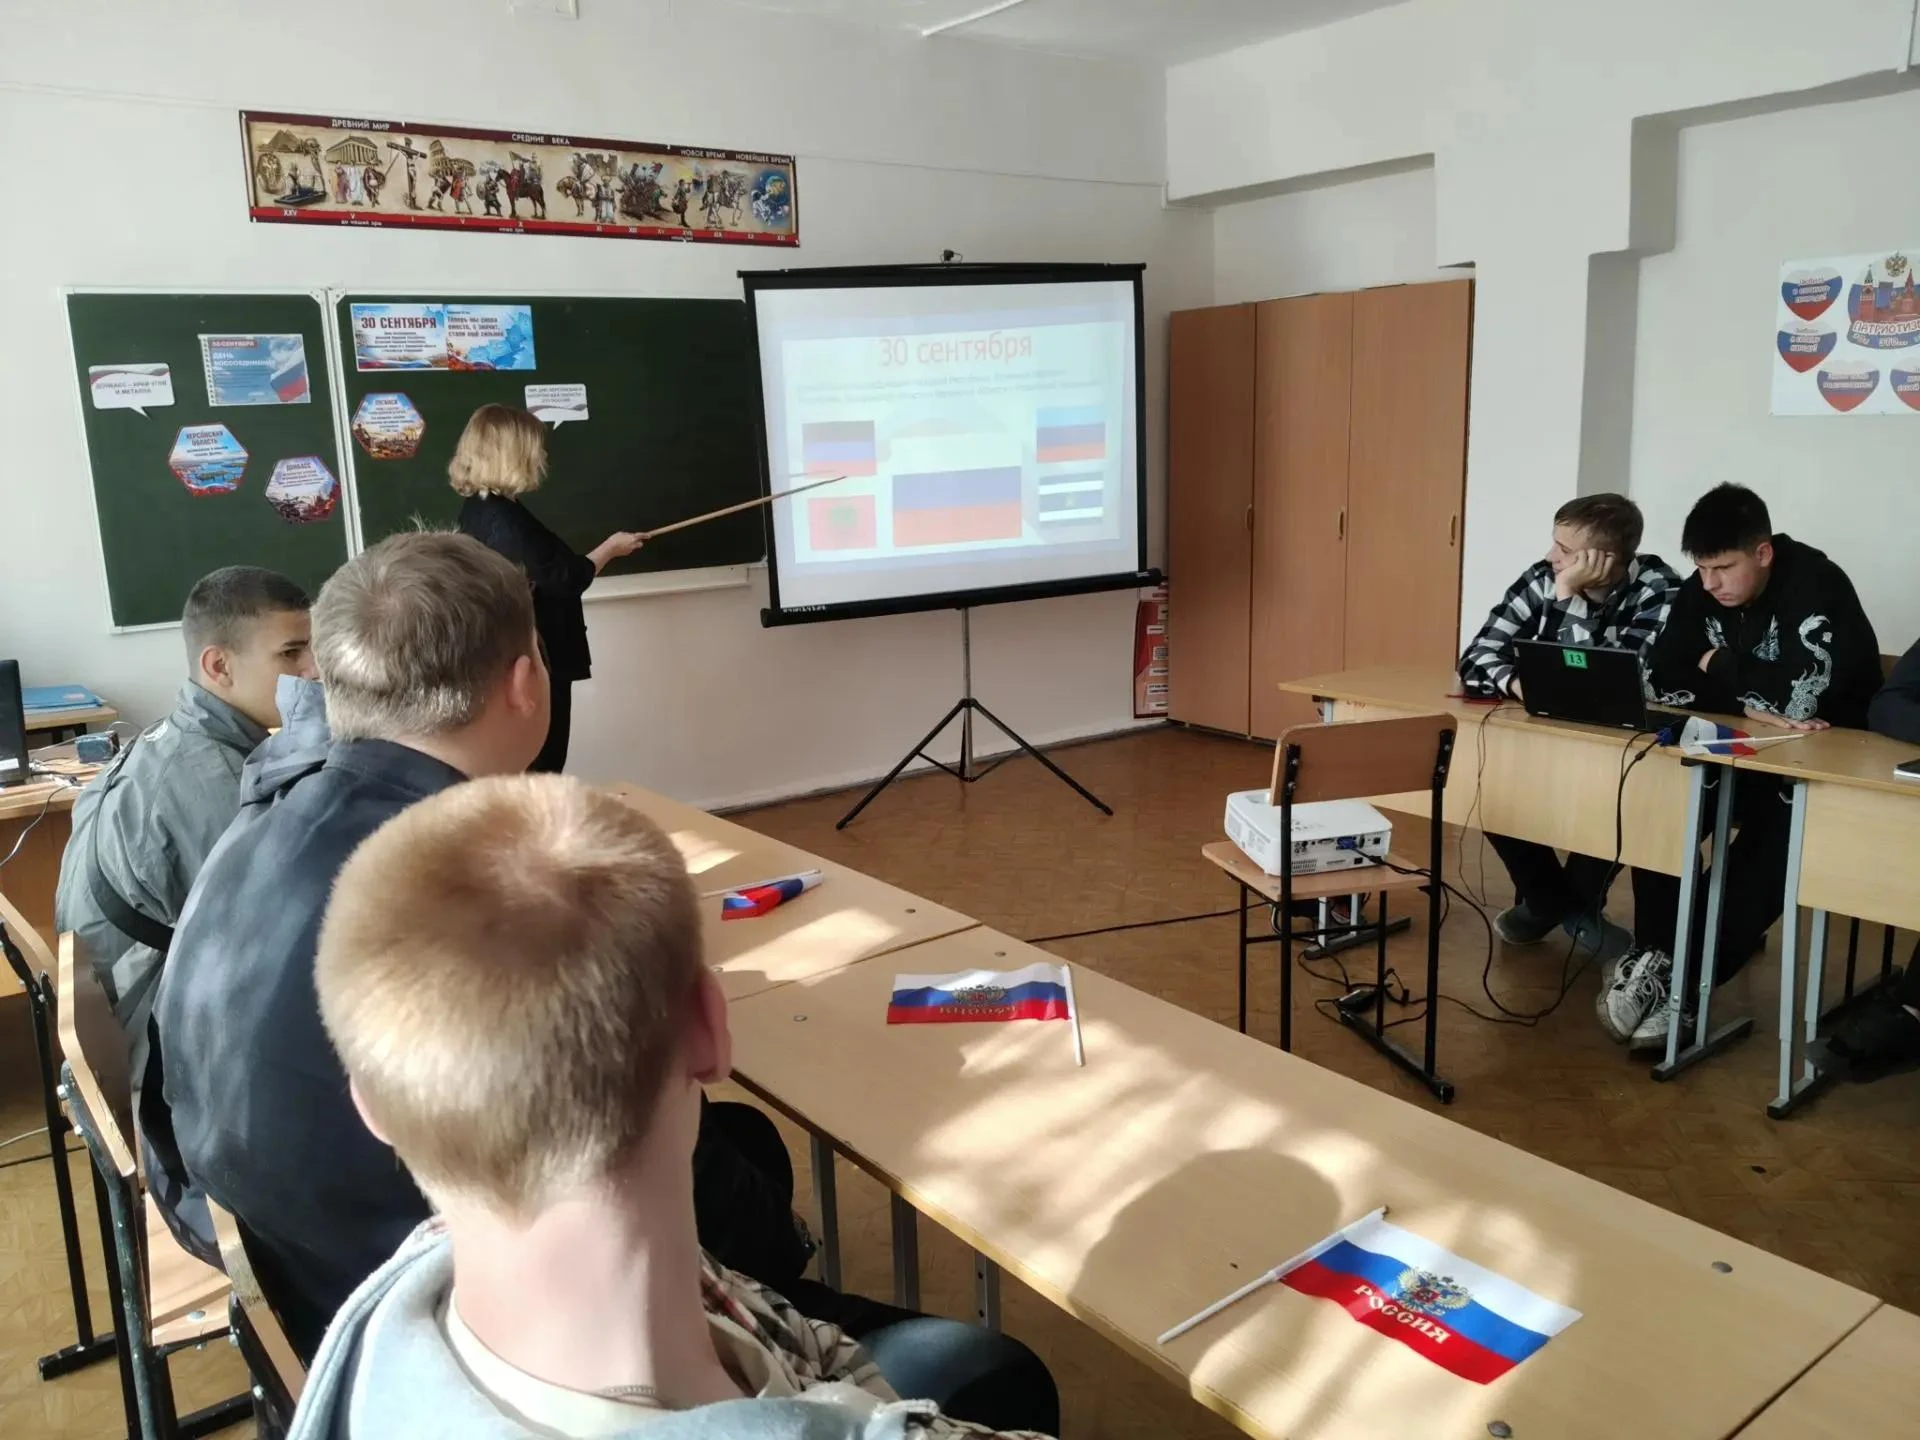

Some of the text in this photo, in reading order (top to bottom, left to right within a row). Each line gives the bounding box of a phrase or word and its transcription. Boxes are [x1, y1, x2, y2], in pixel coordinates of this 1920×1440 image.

[331, 118, 390, 130] ДРЕВНИЙ МИР
[511, 133, 570, 145] СРЕДНИЕ ВЕКА
[680, 149, 726, 159] НОВОЕ ВРЕМЯ
[735, 153, 770, 162] НОВЕЙШЕЕ
[283, 209, 298, 217] XXV
[361, 317, 437, 329] 30 СЕНТЯБРЯ
[1853, 320, 1920, 334] ПАТРИОТИЗ
[879, 331, 1033, 367] 30 сентября
[1569, 654, 1582, 665] 13
[1353, 1284, 1451, 1344] РОССИЯ
